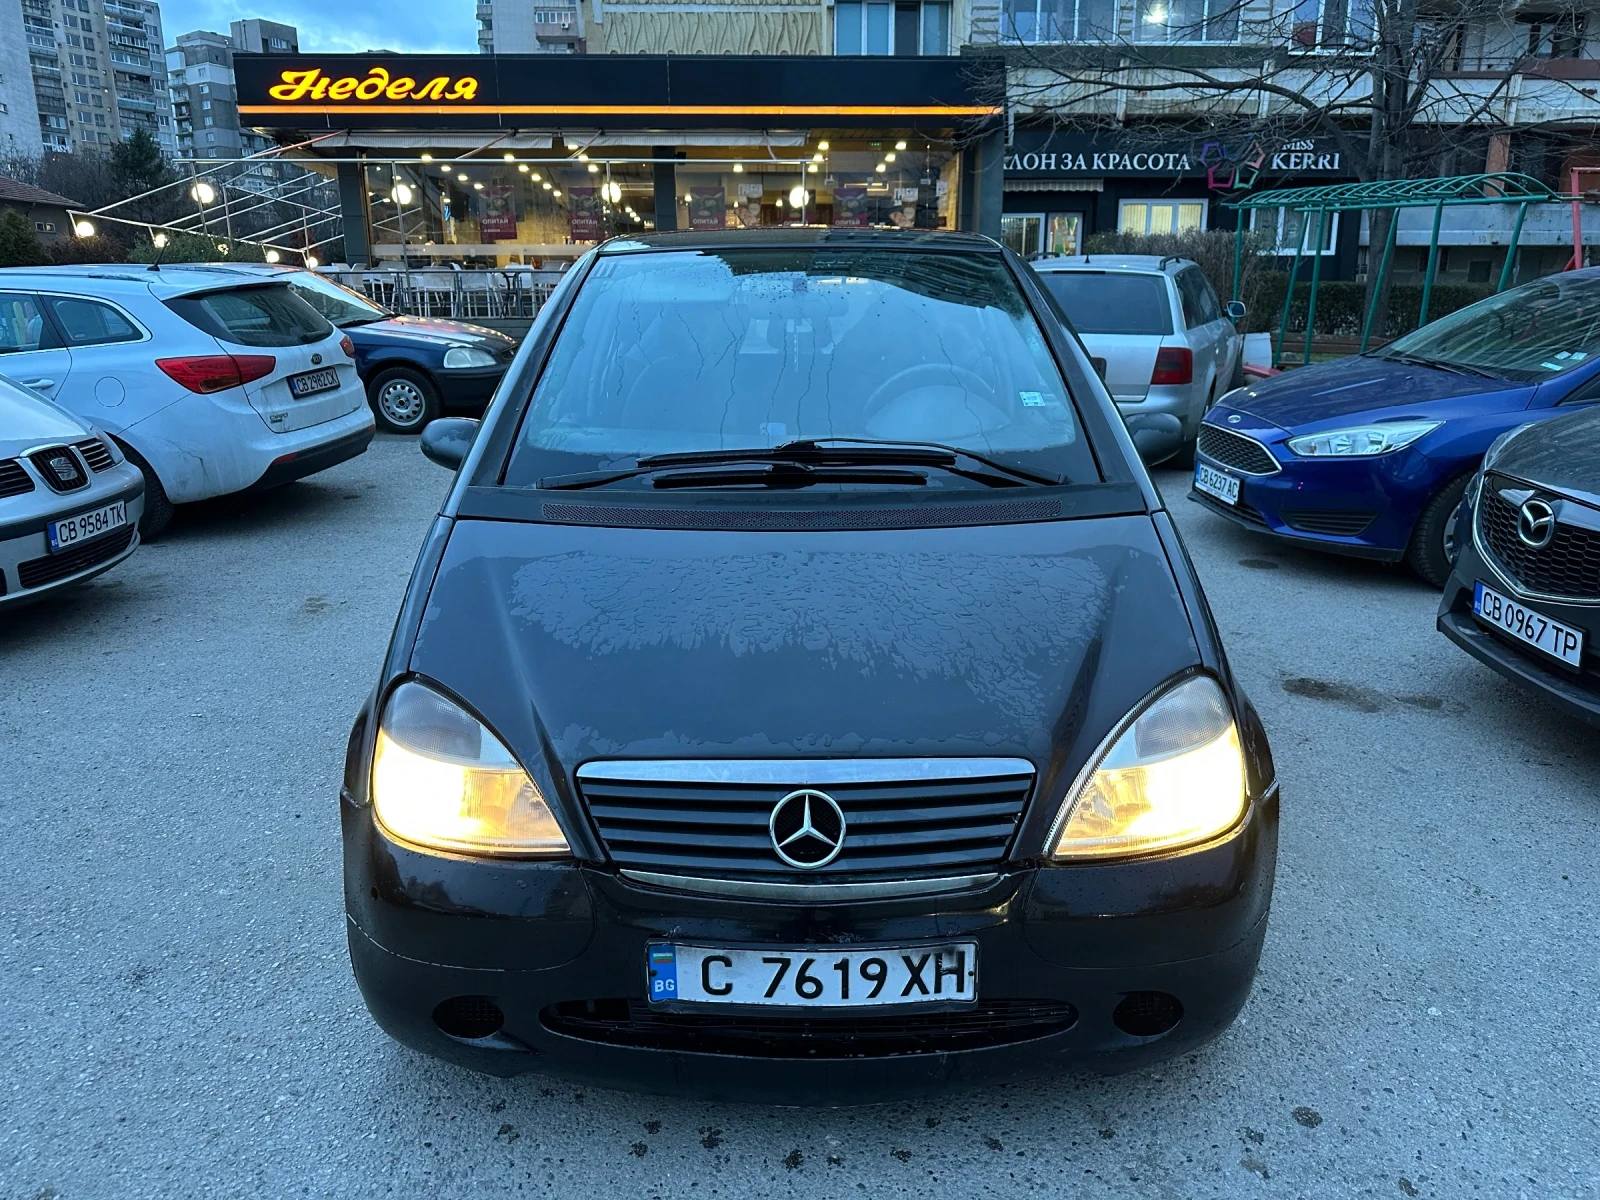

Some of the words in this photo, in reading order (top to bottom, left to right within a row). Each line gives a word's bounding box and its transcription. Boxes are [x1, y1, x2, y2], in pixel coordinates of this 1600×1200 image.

[269, 67, 478, 100] Неделя
[1003, 153, 1056, 170] ЛОН
[1061, 153, 1087, 170] ЗА
[1092, 153, 1191, 170] КРАСОТА
[1270, 152, 1340, 170] KERRI
[693, 217, 719, 225] ОПИТАЙ
[309, 373, 328, 390] 2982
[1200, 467, 1209, 484] CB
[1209, 472, 1227, 493] 6237
[59, 521, 77, 543] CB
[80, 509, 109, 537] 9584
[110, 503, 123, 526] TK
[1483, 591, 1502, 621] CB
[1505, 604, 1548, 643] 0967
[1552, 624, 1577, 657] TP
[655, 980, 675, 993] BG
[701, 955, 733, 996] C
[762, 957, 888, 1000] 7619
[900, 950, 966, 997] XH
